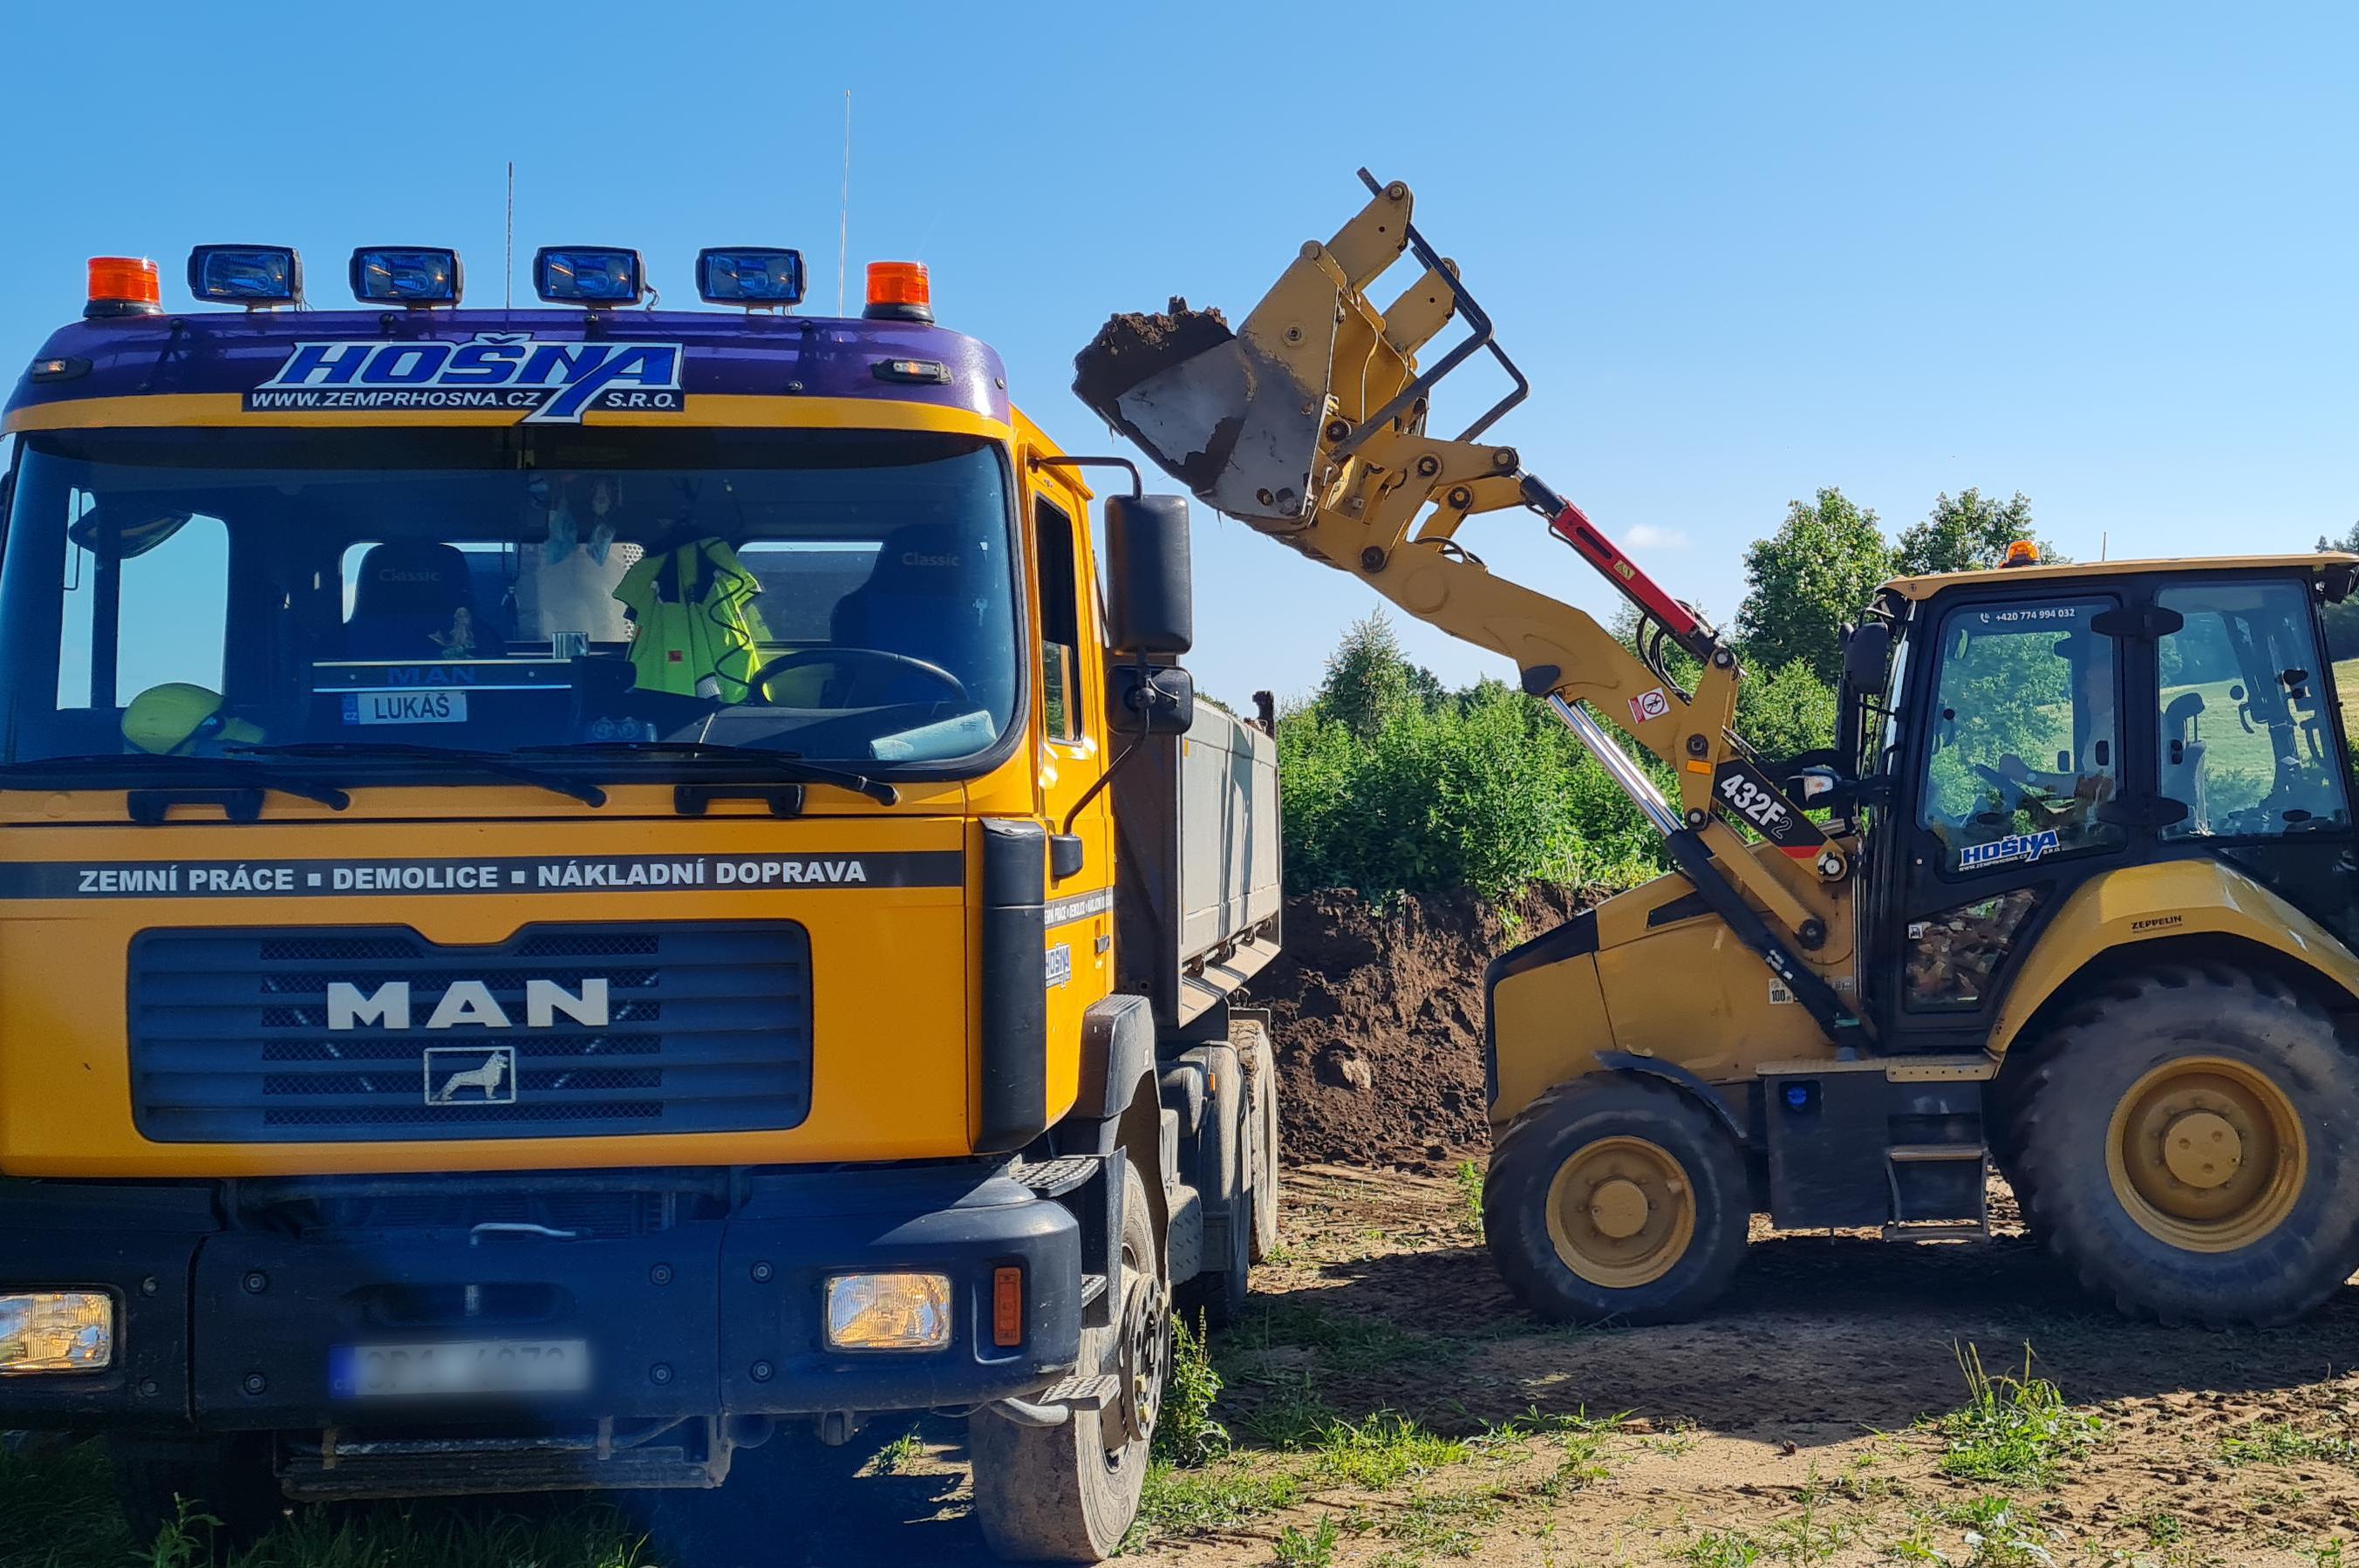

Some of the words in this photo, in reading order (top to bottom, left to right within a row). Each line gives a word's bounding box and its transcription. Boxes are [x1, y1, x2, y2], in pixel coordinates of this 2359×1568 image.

[266, 334, 682, 420] HOŠNA
[251, 392, 542, 407] WWW.ZEMPRHOSNA.CZ
[605, 392, 677, 408] S.R.O.
[902, 551, 961, 566] Classic
[1995, 612, 2018, 622] +420
[2020, 611, 2037, 621] 774
[2039, 610, 2056, 619] 994
[2058, 609, 2076, 617] 032
[387, 665, 475, 685] MAN
[374, 692, 450, 719] LUKÁŠ
[343, 712, 358, 720] CZ
[1961, 831, 2059, 864] HOŠNA
[78, 864, 178, 892] ZEMNÍ
[188, 863, 294, 891] PRÁCE
[333, 866, 498, 890] DEMOLICE
[537, 858, 705, 887] NÁKLADNÍ
[716, 862, 866, 884] DOPRAVA
[328, 978, 609, 1030] MAN
[1771, 989, 1786, 1002] 100
